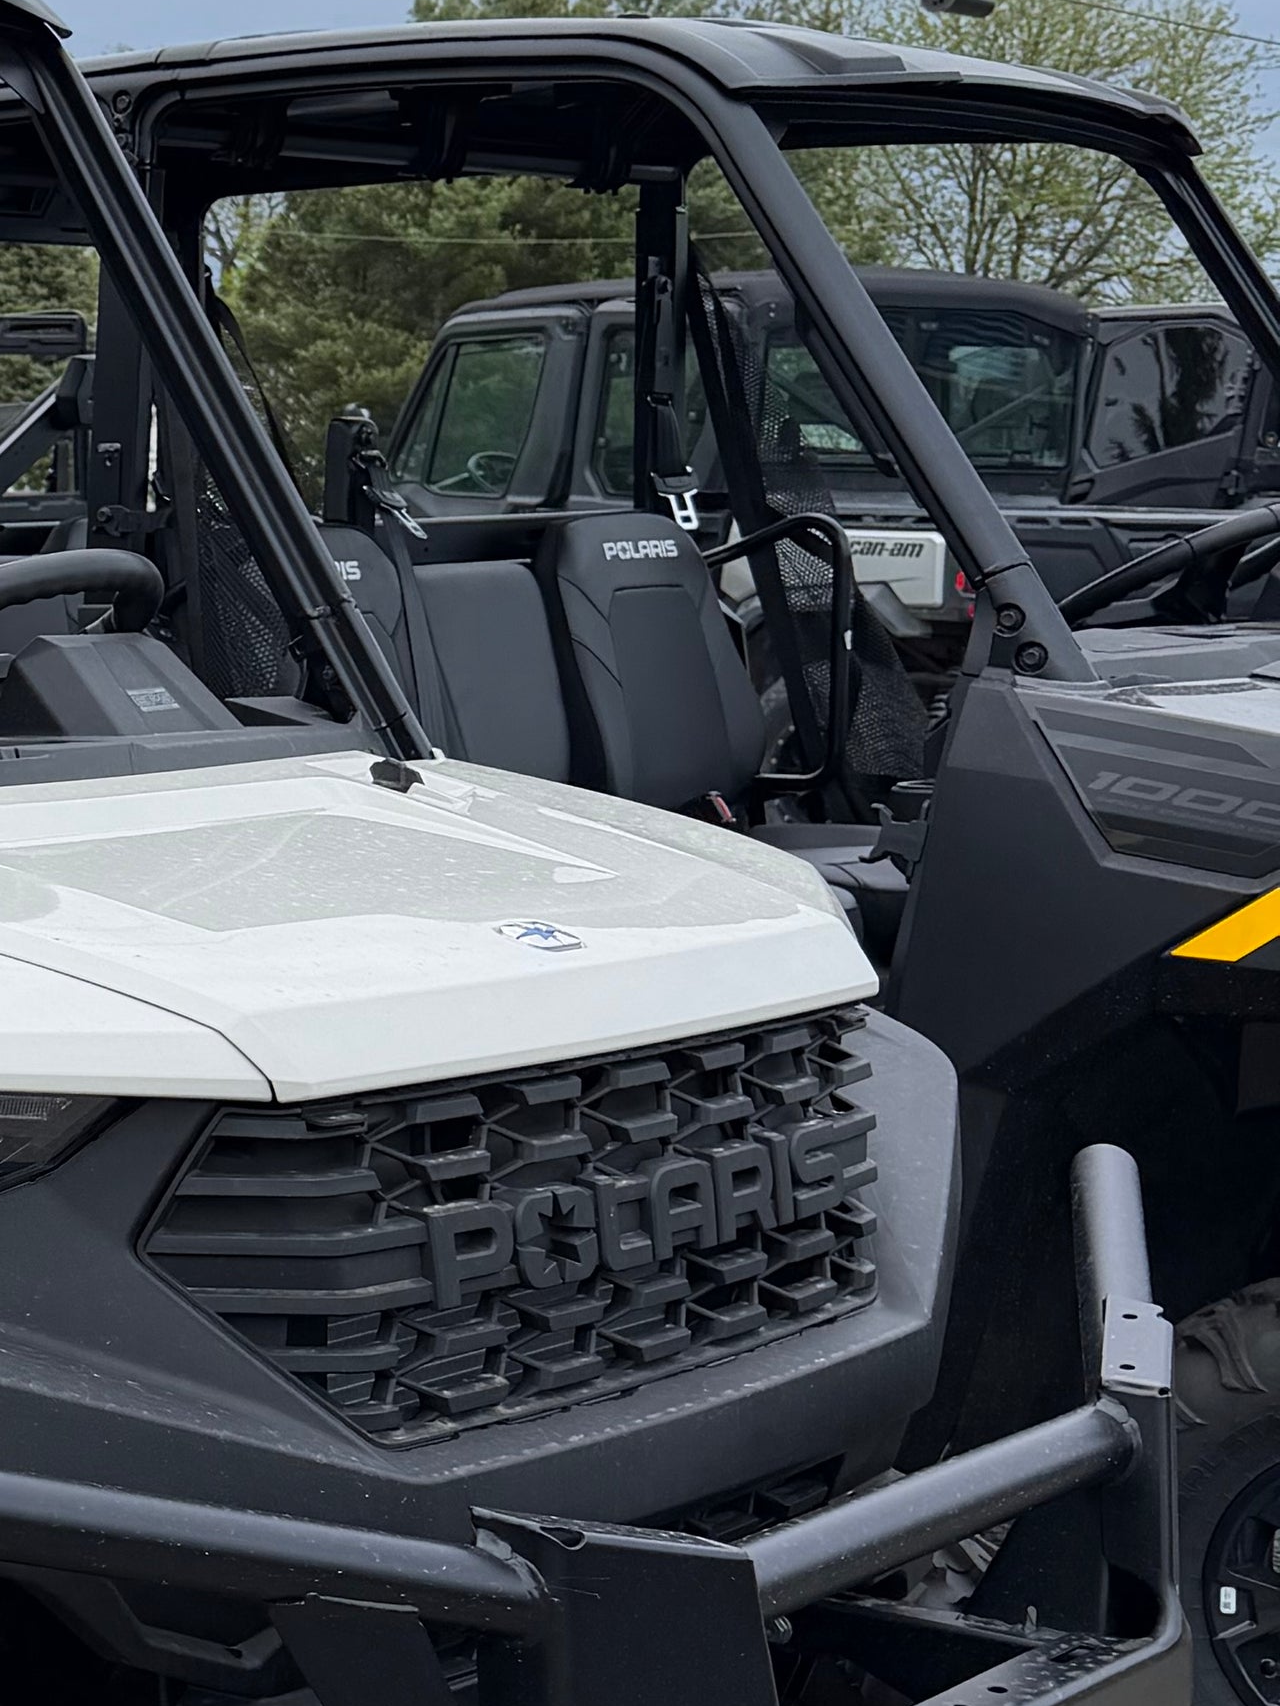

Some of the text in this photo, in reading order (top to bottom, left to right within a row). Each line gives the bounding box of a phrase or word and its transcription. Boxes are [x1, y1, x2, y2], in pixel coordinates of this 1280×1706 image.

[602, 539, 679, 561] POLARIS
[849, 540, 925, 558] can-am
[425, 1120, 842, 1311] POLARIS
